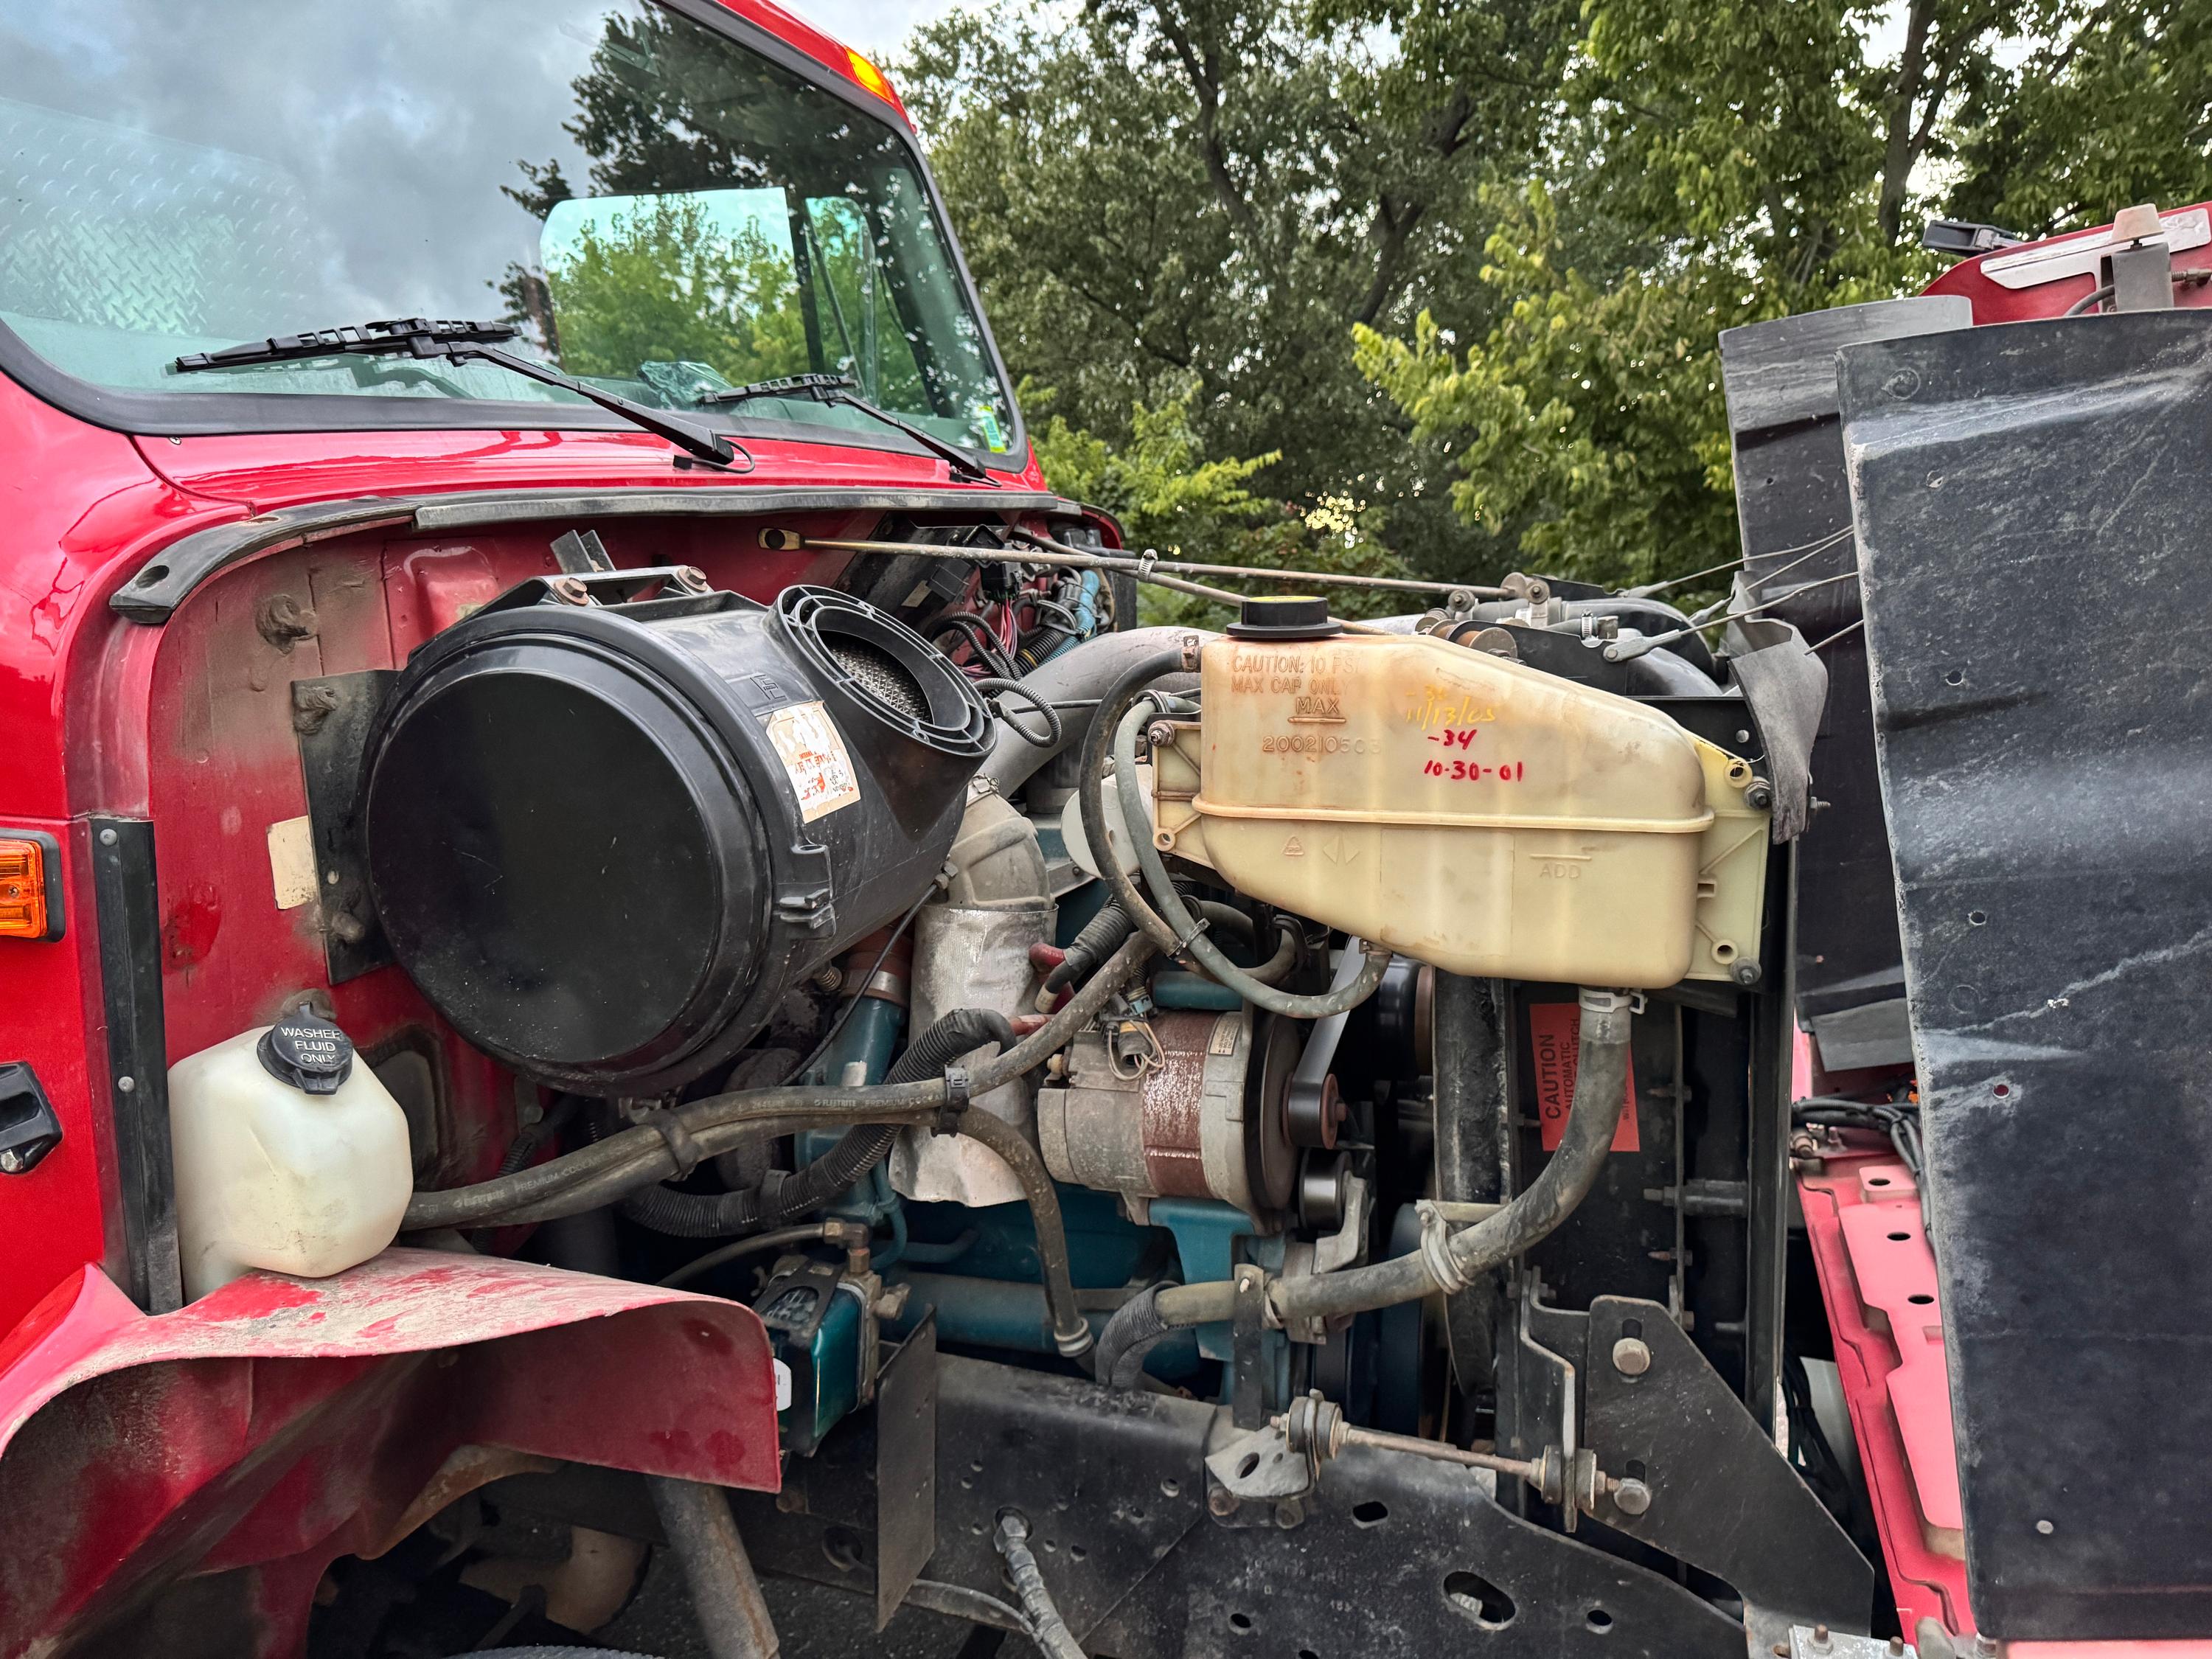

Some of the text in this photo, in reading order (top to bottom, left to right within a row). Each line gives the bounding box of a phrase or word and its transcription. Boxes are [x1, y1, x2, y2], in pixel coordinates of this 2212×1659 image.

[1310, 655, 1326, 673] 10
[1231, 676, 1351, 695] MAX CAP ONLY
[1295, 696, 1340, 714] MAX
[1427, 728, 1478, 751] -34
[1539, 862, 1582, 880] ADD
[280, 1027, 341, 1041] WASHER
[295, 1040, 336, 1052] FLUID
[300, 1053, 336, 1065] ONLY
[1539, 1034, 1562, 1119] CAUTION
[1559, 1042, 1574, 1111] AUTOMATIC
[514, 1172, 560, 1192] PREMIUM
